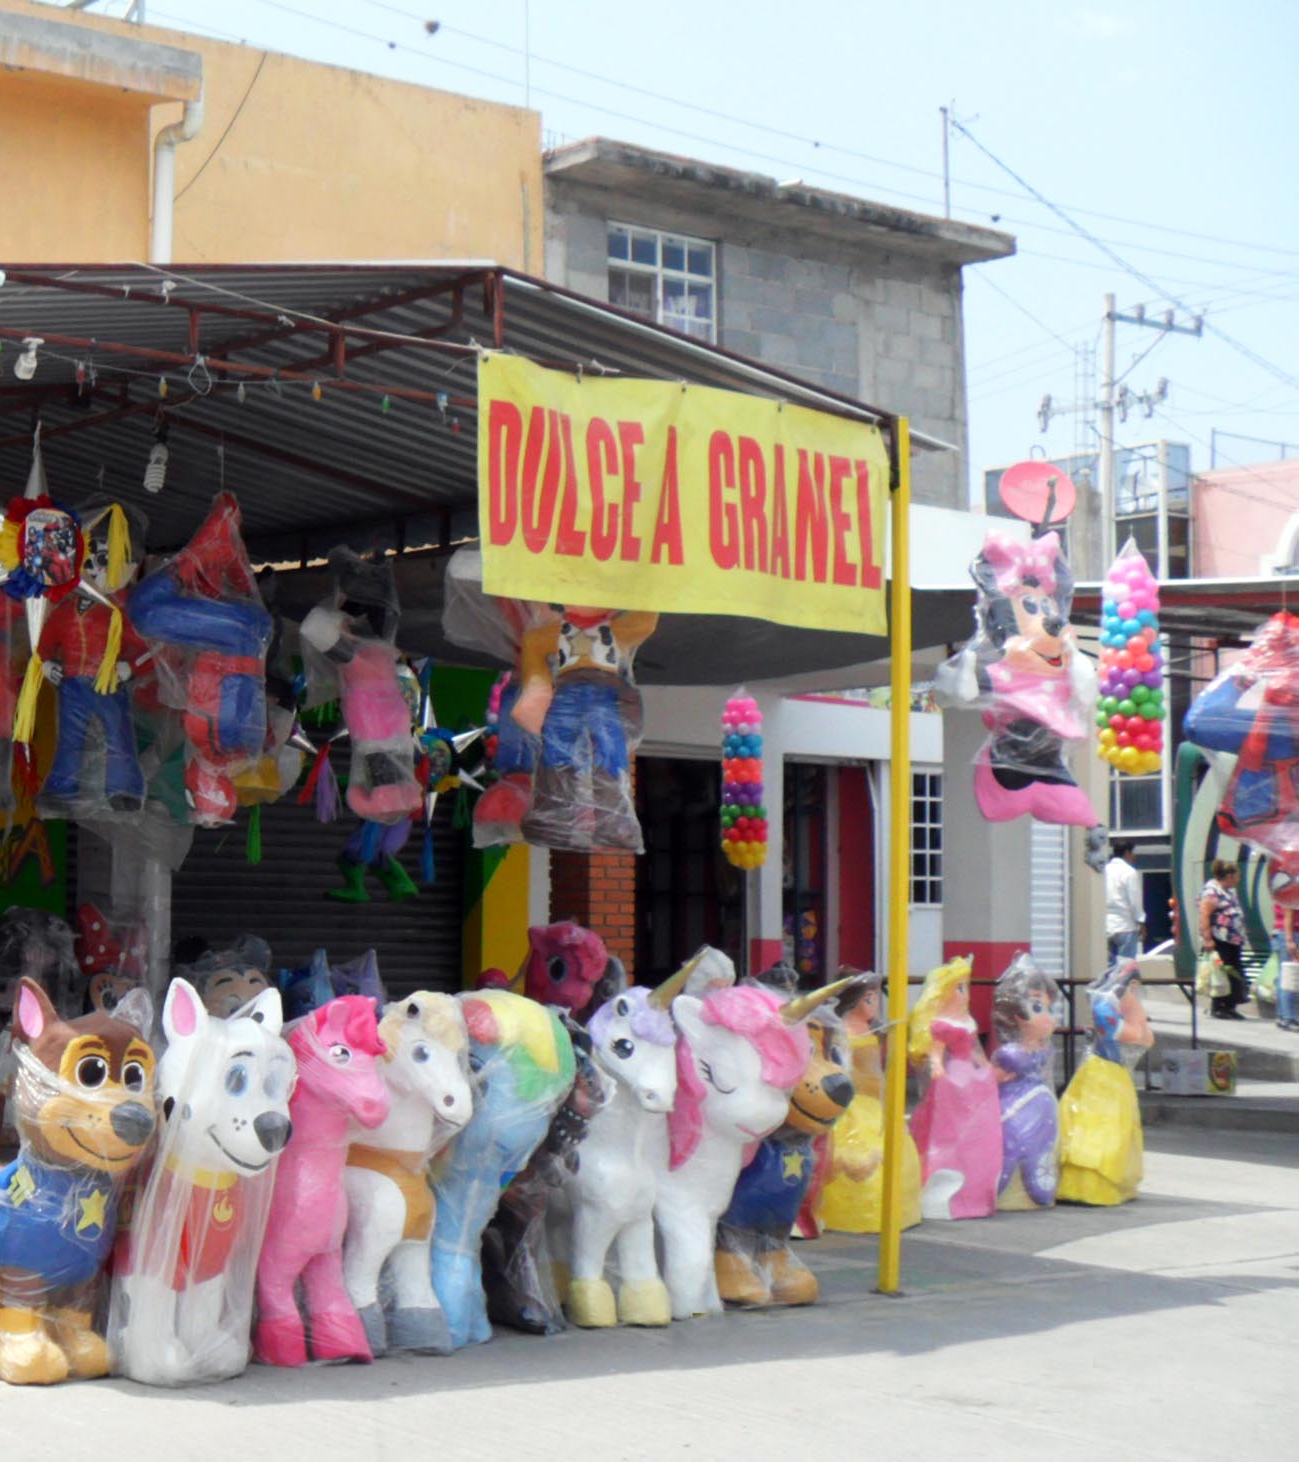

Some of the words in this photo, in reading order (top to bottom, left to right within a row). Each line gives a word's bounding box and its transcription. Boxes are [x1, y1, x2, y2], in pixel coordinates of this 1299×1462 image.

[488, 399, 645, 563] DULCE
[650, 424, 685, 566] A
[708, 429, 882, 590] GRANEL
